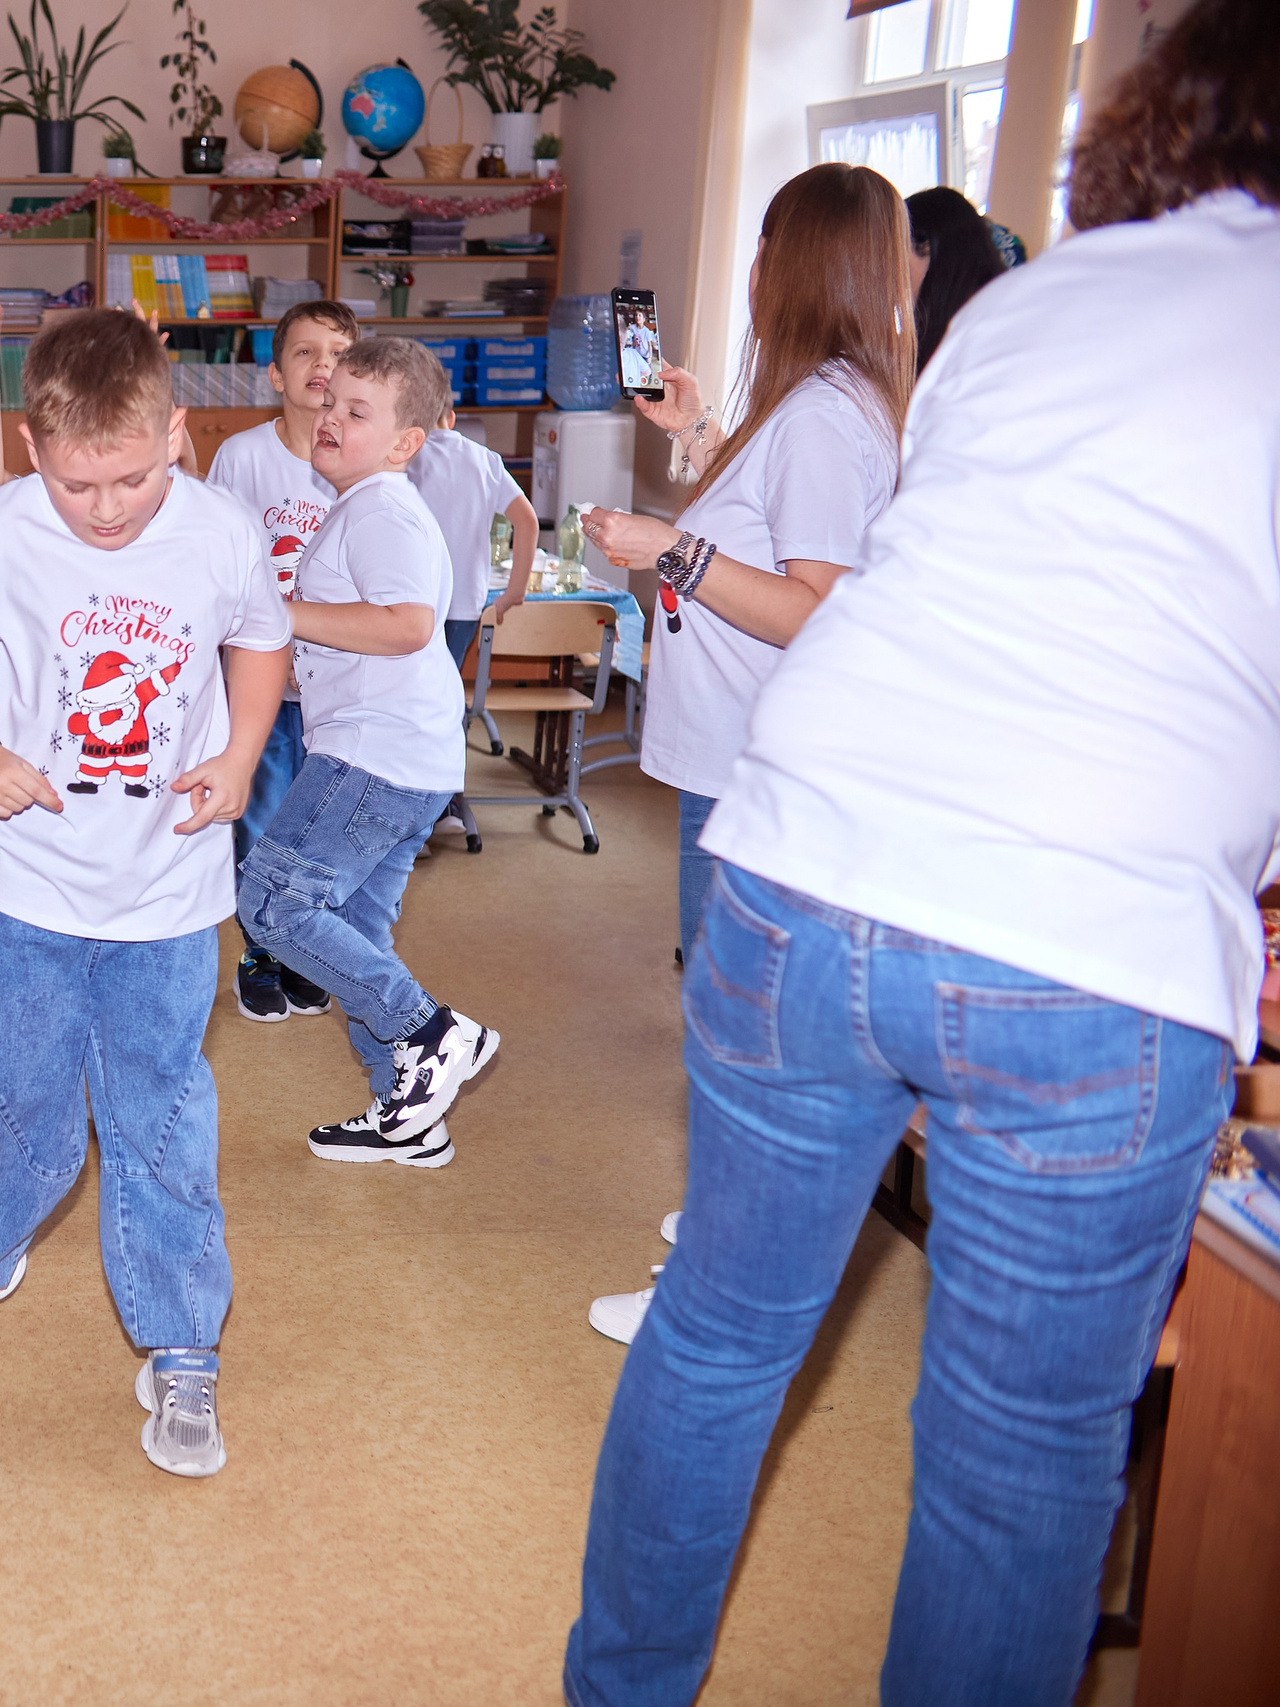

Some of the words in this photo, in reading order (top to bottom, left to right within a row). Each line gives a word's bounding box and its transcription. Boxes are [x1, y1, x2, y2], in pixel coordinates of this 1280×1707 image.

[263, 506, 322, 534] Christ
[293, 499, 328, 516] Merr
[104, 594, 173, 624] Merry
[60, 610, 196, 665] Christmas
[415, 1066, 431, 1086] B
